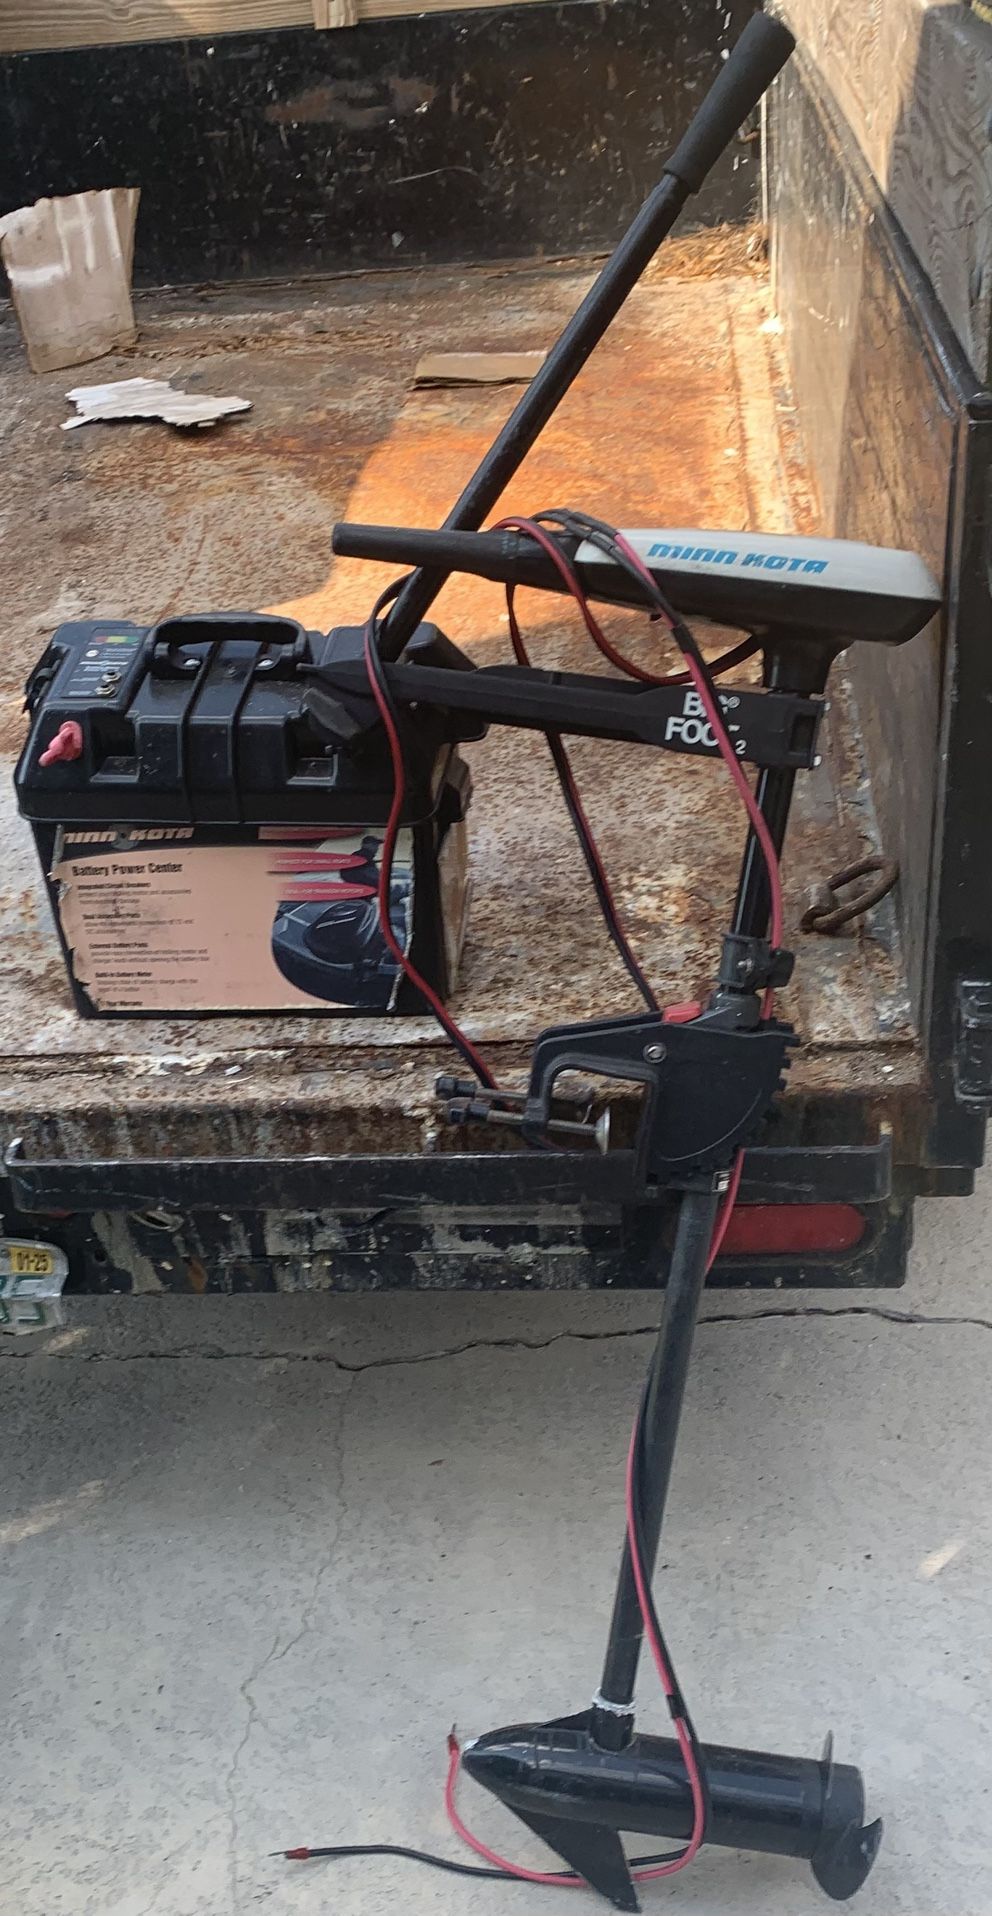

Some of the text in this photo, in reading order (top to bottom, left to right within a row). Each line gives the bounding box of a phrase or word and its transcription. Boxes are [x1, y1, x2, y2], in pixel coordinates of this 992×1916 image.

[741, 553, 829, 574] KOTA
[664, 716, 740, 747] FOO
[130, 828, 194, 841] KOTA
[72, 862, 183, 876] Battery Power Center
[16, 1251, 49, 1272] 01-25
